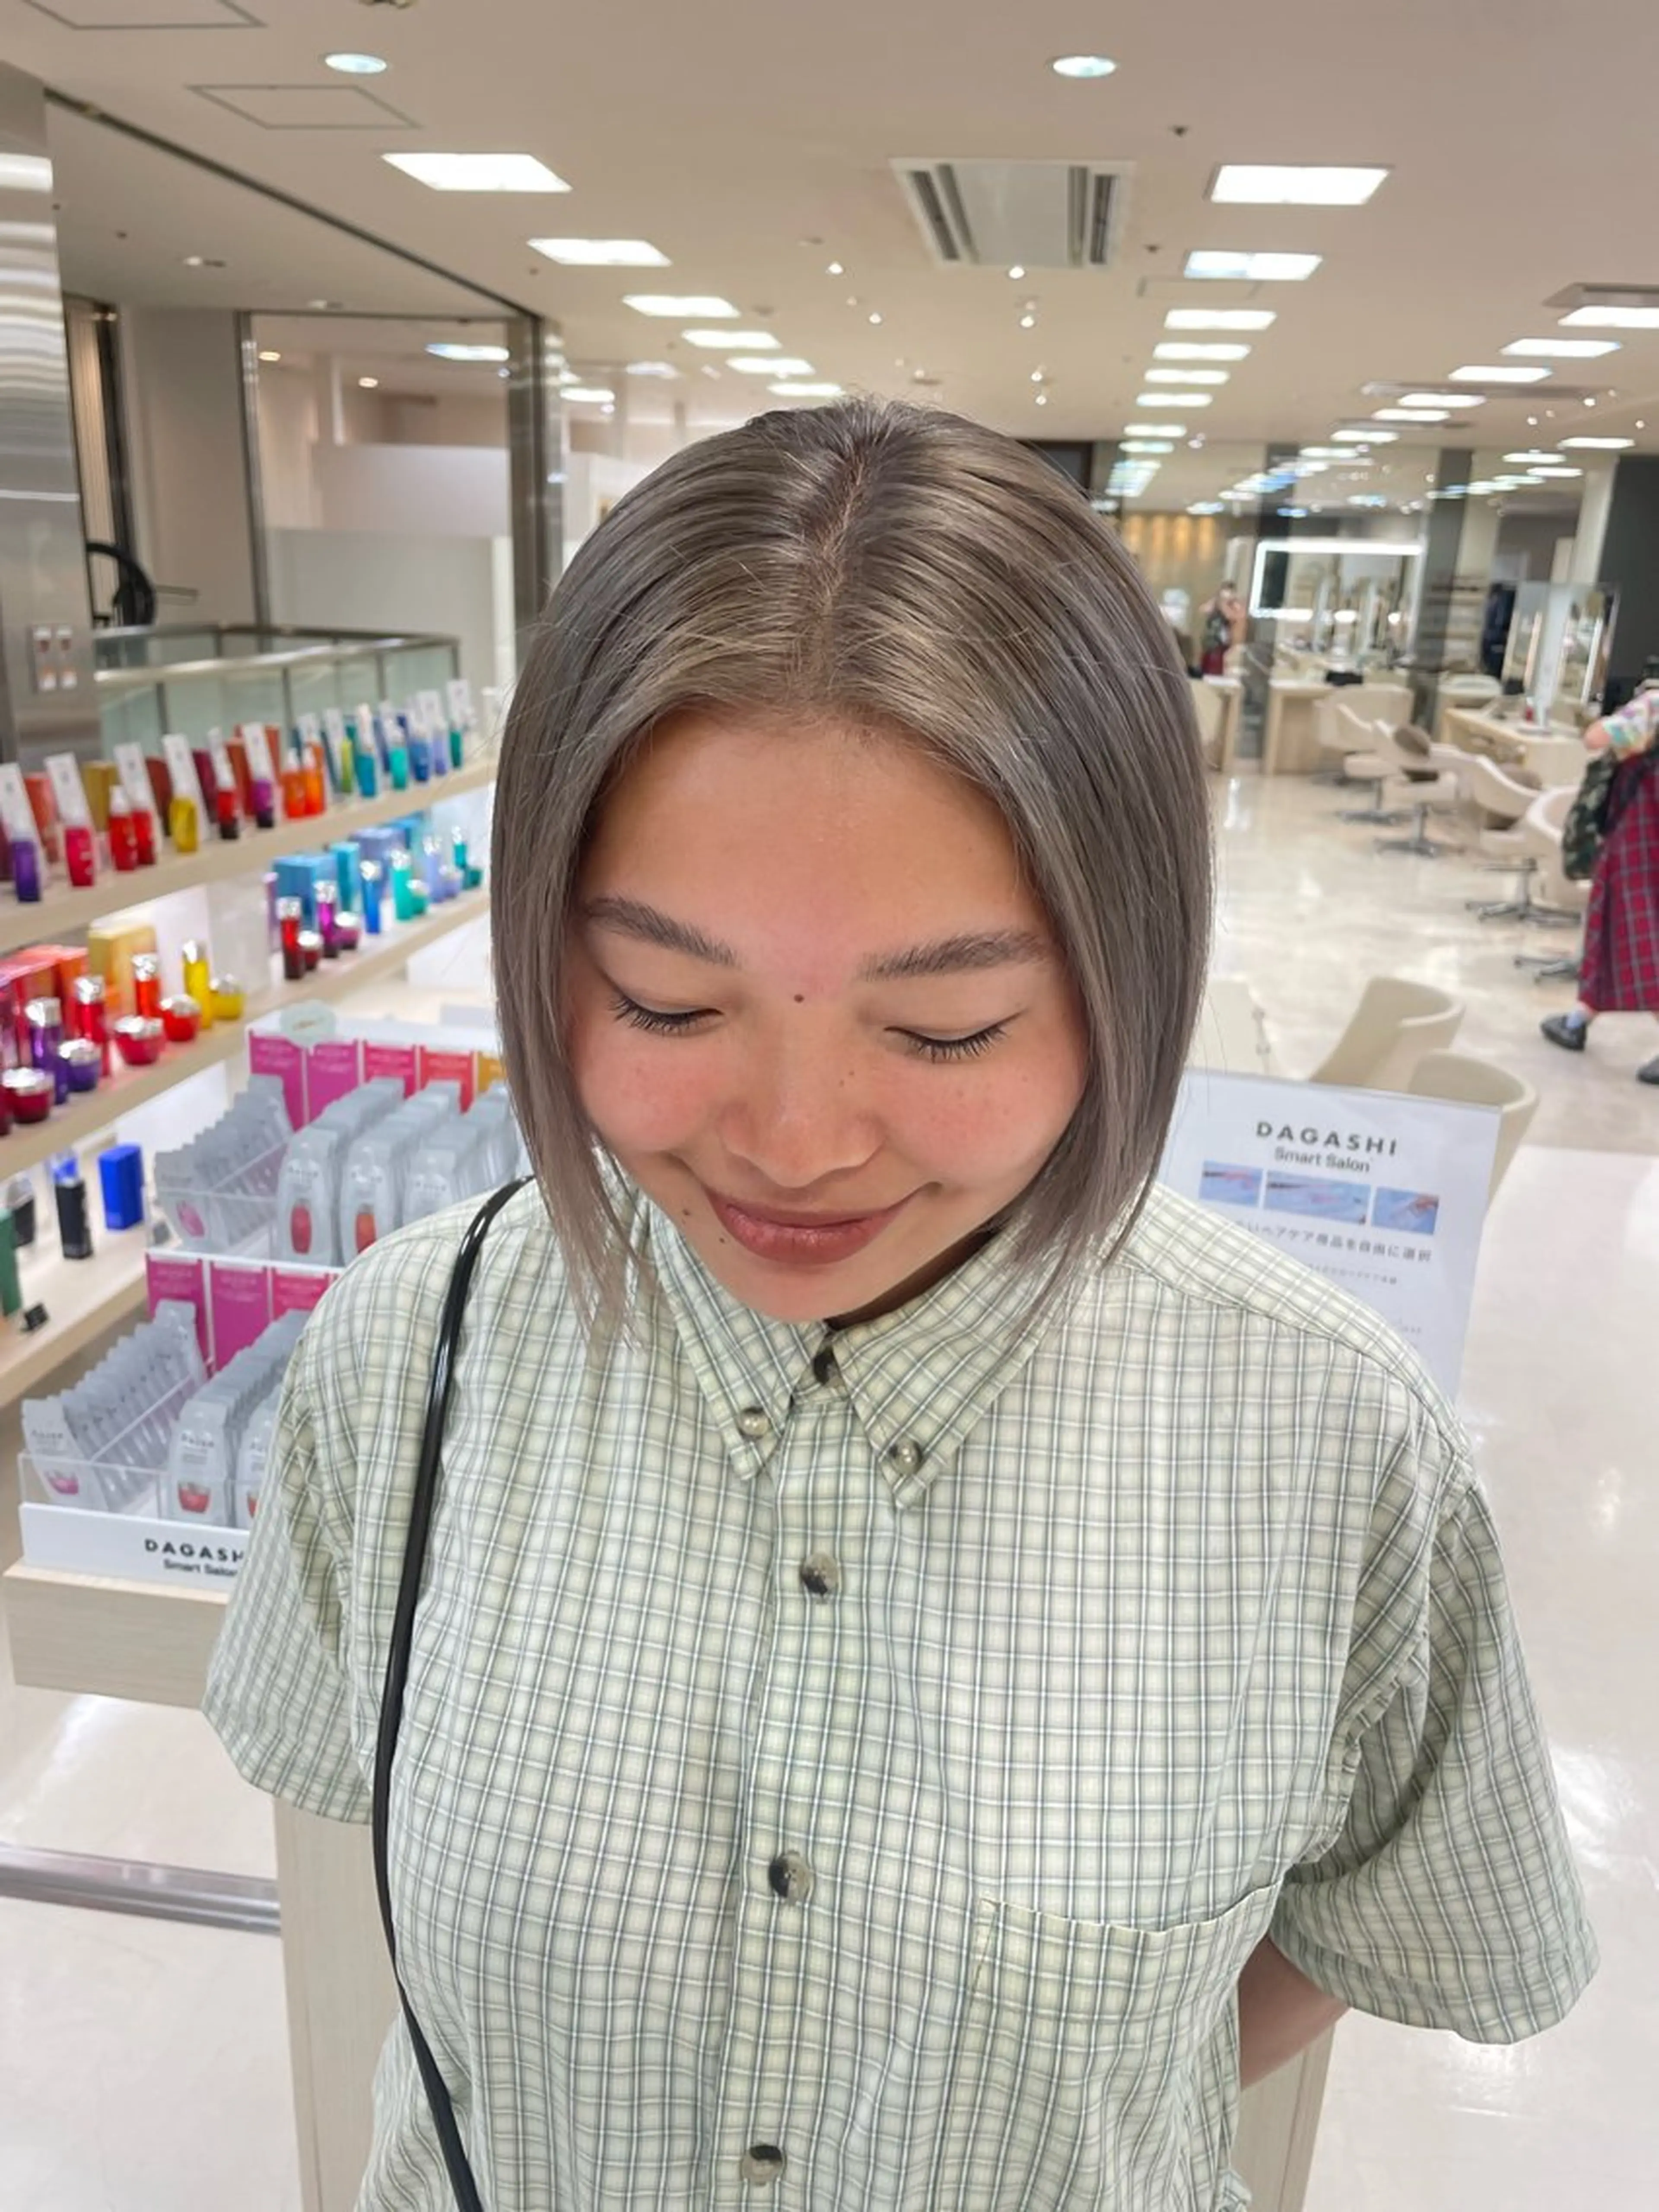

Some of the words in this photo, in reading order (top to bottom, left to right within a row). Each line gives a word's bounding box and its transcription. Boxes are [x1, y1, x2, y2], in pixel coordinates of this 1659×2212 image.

[1255, 1121, 1397, 1157] DAGASHI
[1274, 1146, 1322, 1165] Smart
[1325, 1152, 1370, 1173] Salon
[144, 1538, 245, 1563] DAGASH
